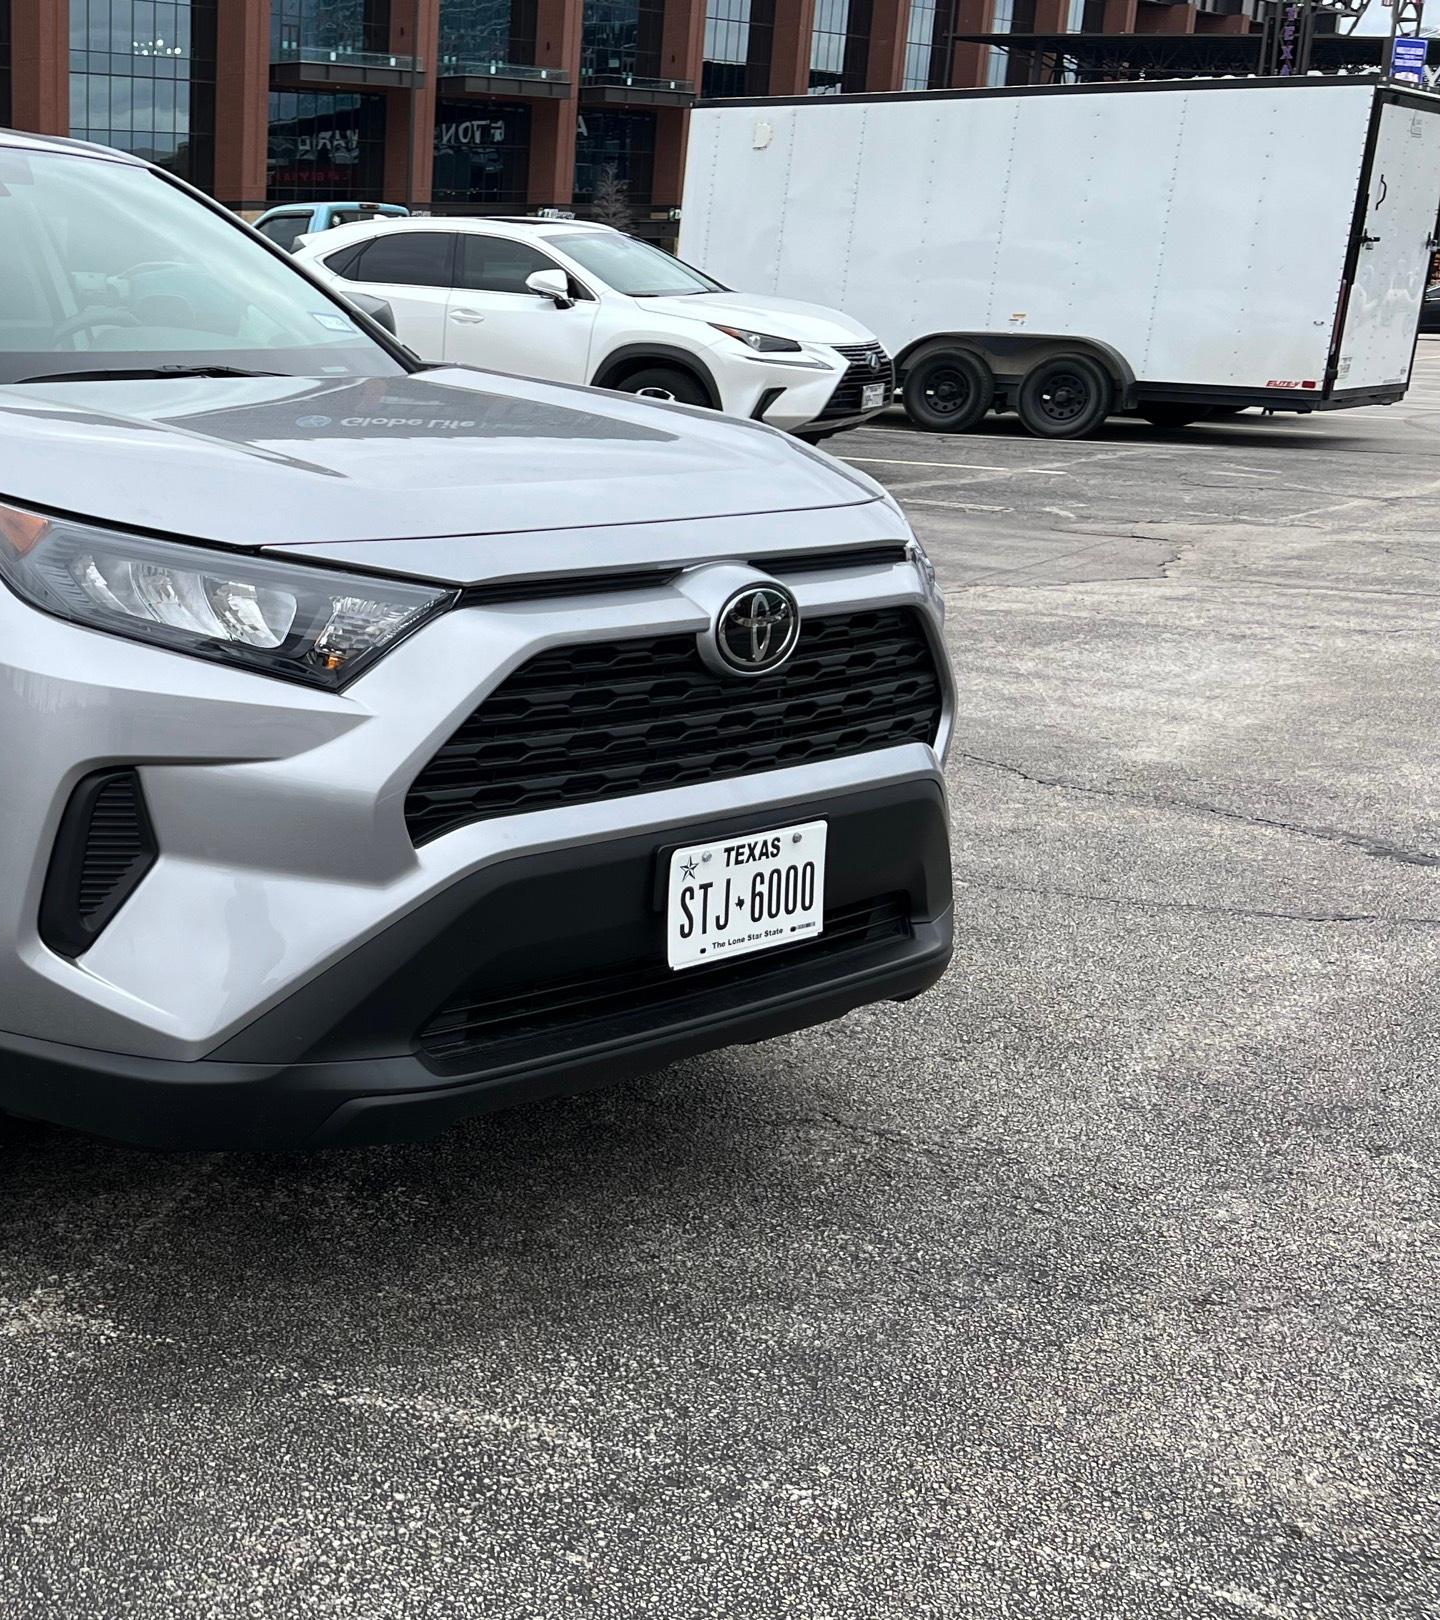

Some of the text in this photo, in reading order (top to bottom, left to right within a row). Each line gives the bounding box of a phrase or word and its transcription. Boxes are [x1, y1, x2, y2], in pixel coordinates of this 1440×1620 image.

[723, 837, 781, 868] TEXAS
[750, 861, 815, 923] 6000
[712, 927, 784, 949] The Lone Star State
